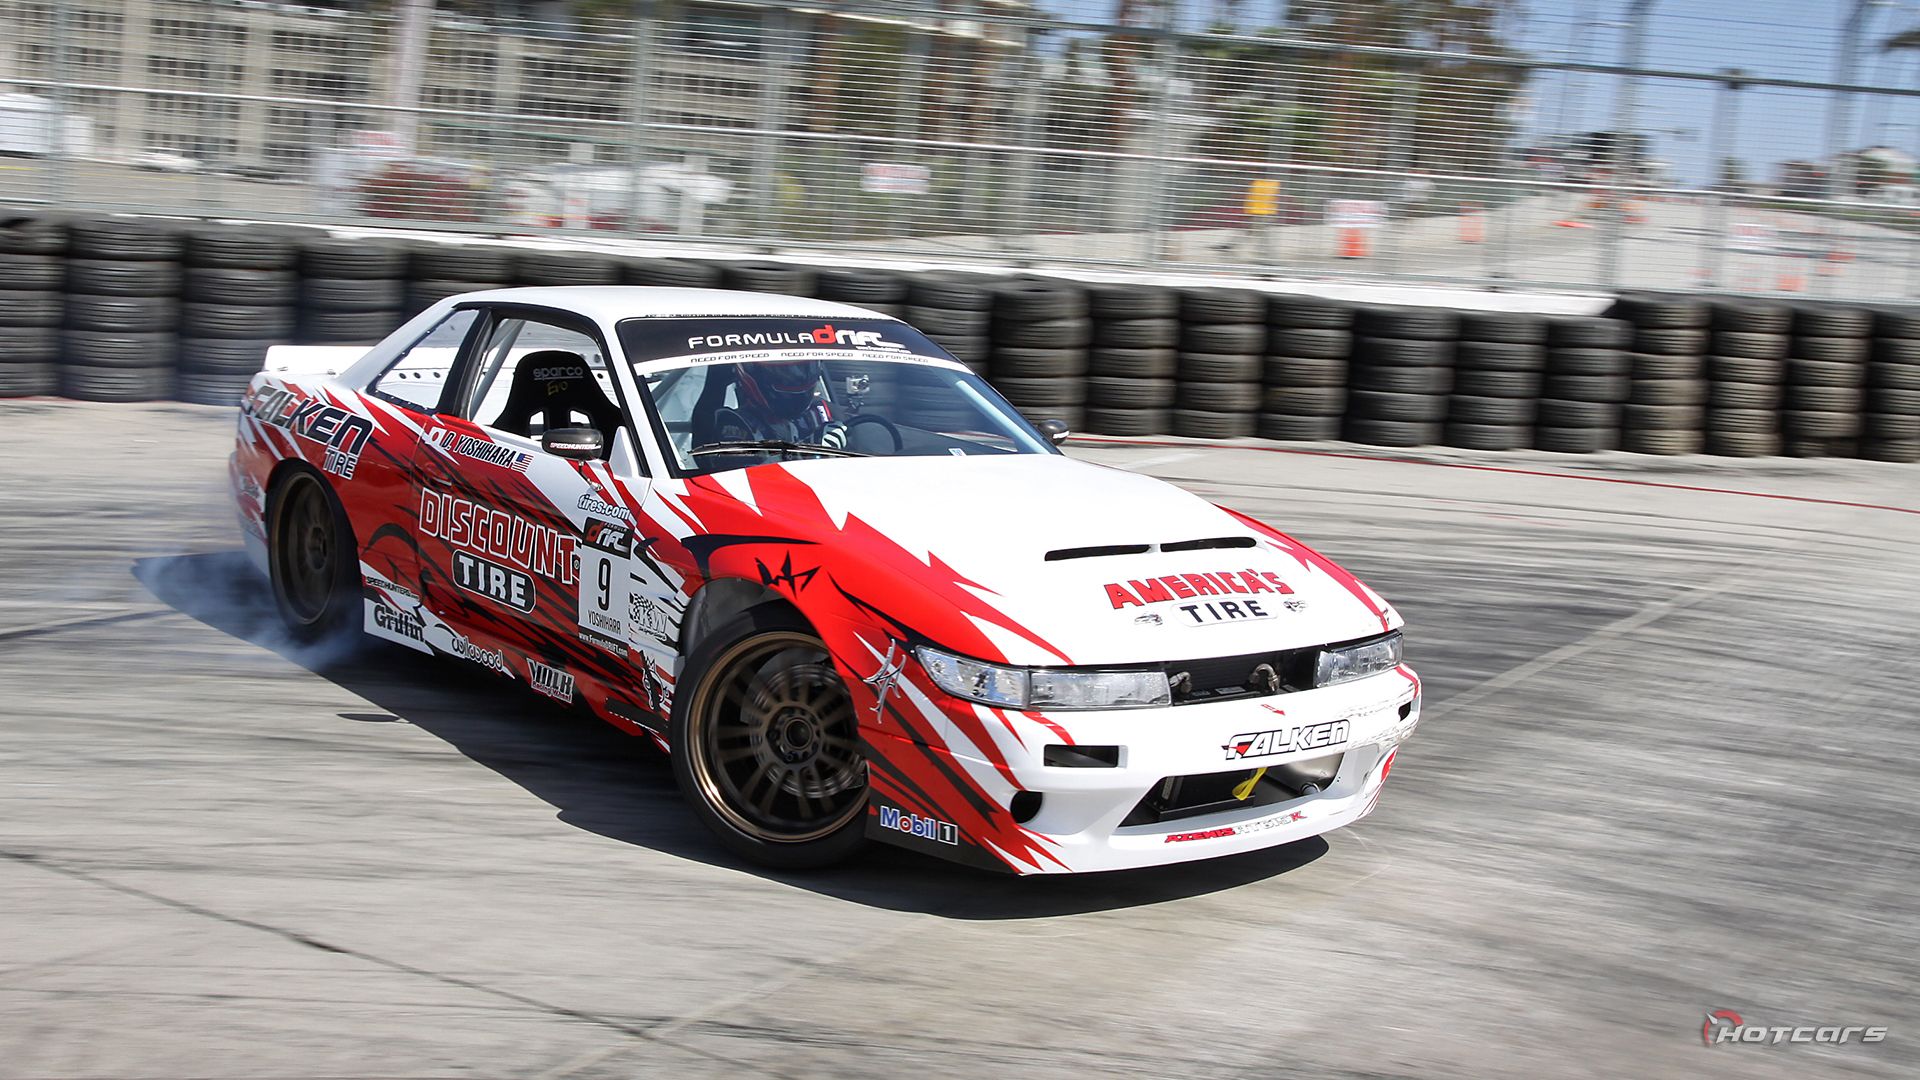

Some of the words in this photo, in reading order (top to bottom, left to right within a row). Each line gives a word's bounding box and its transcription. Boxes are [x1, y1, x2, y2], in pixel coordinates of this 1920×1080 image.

[687, 331, 815, 349] FORMULA
[738, 352, 770, 360] SPEED
[532, 366, 584, 379] sparco
[322, 447, 359, 481] TIRE
[439, 432, 452, 450] D.
[453, 434, 516, 468] YOSHIHARA
[577, 493, 631, 521] tires.com
[418, 487, 575, 585] DISCOUNT
[458, 555, 526, 607] TIRE
[598, 557, 611, 611] 9
[1104, 568, 1295, 610] AMERICA'S
[374, 603, 425, 643] Griffin
[587, 609, 622, 635] YOSHIHARA
[1179, 600, 1268, 623] TIRE
[1221, 718, 1351, 761] FALKEN
[880, 805, 937, 841] Mobil
